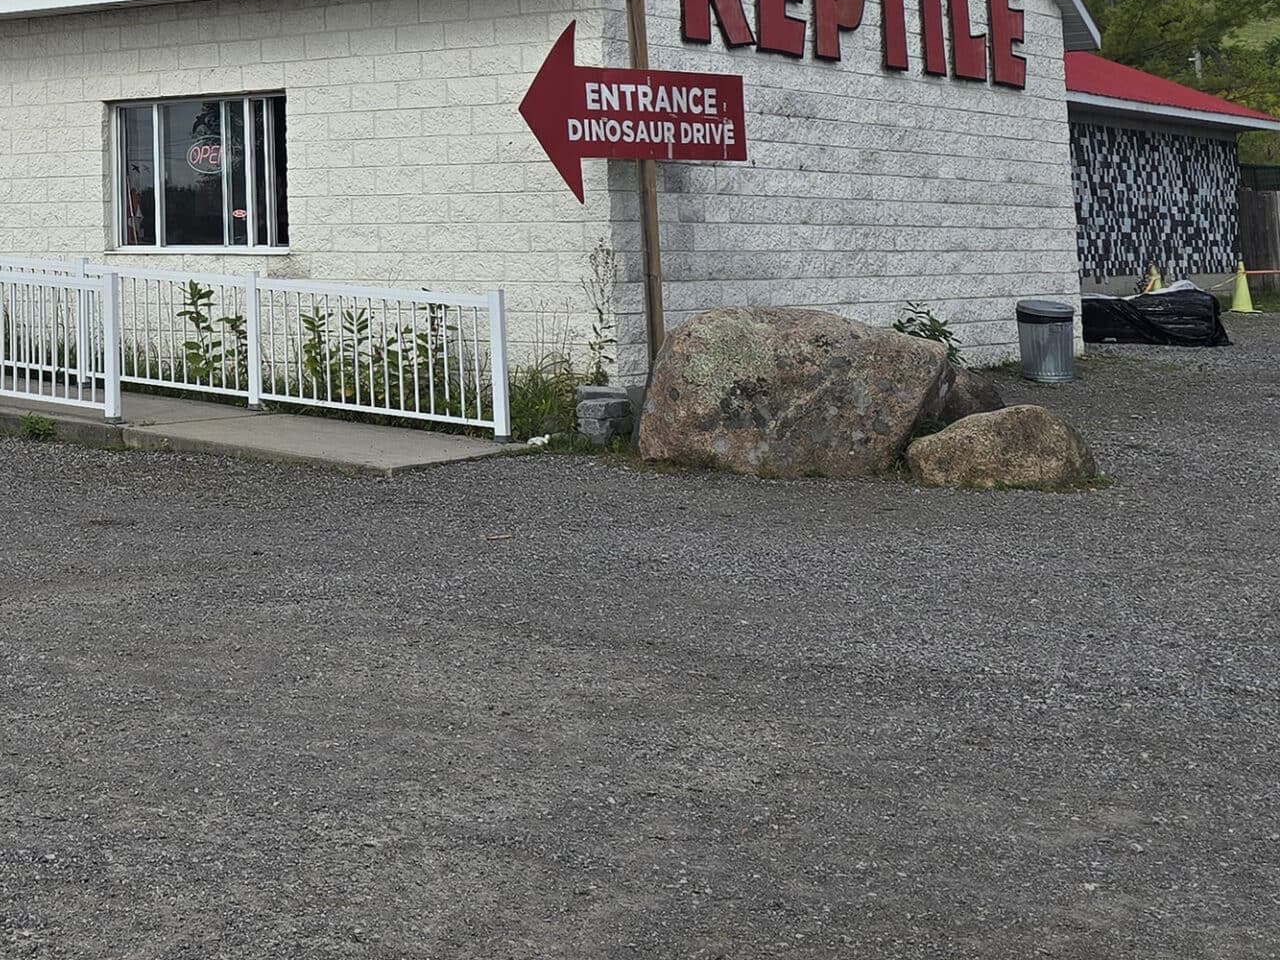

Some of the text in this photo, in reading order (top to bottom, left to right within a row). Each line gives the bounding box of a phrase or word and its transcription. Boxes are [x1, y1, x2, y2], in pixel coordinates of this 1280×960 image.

[585, 82, 717, 115] ENTRANCE
[567, 118, 735, 145] DINOSAUR DRIVE
